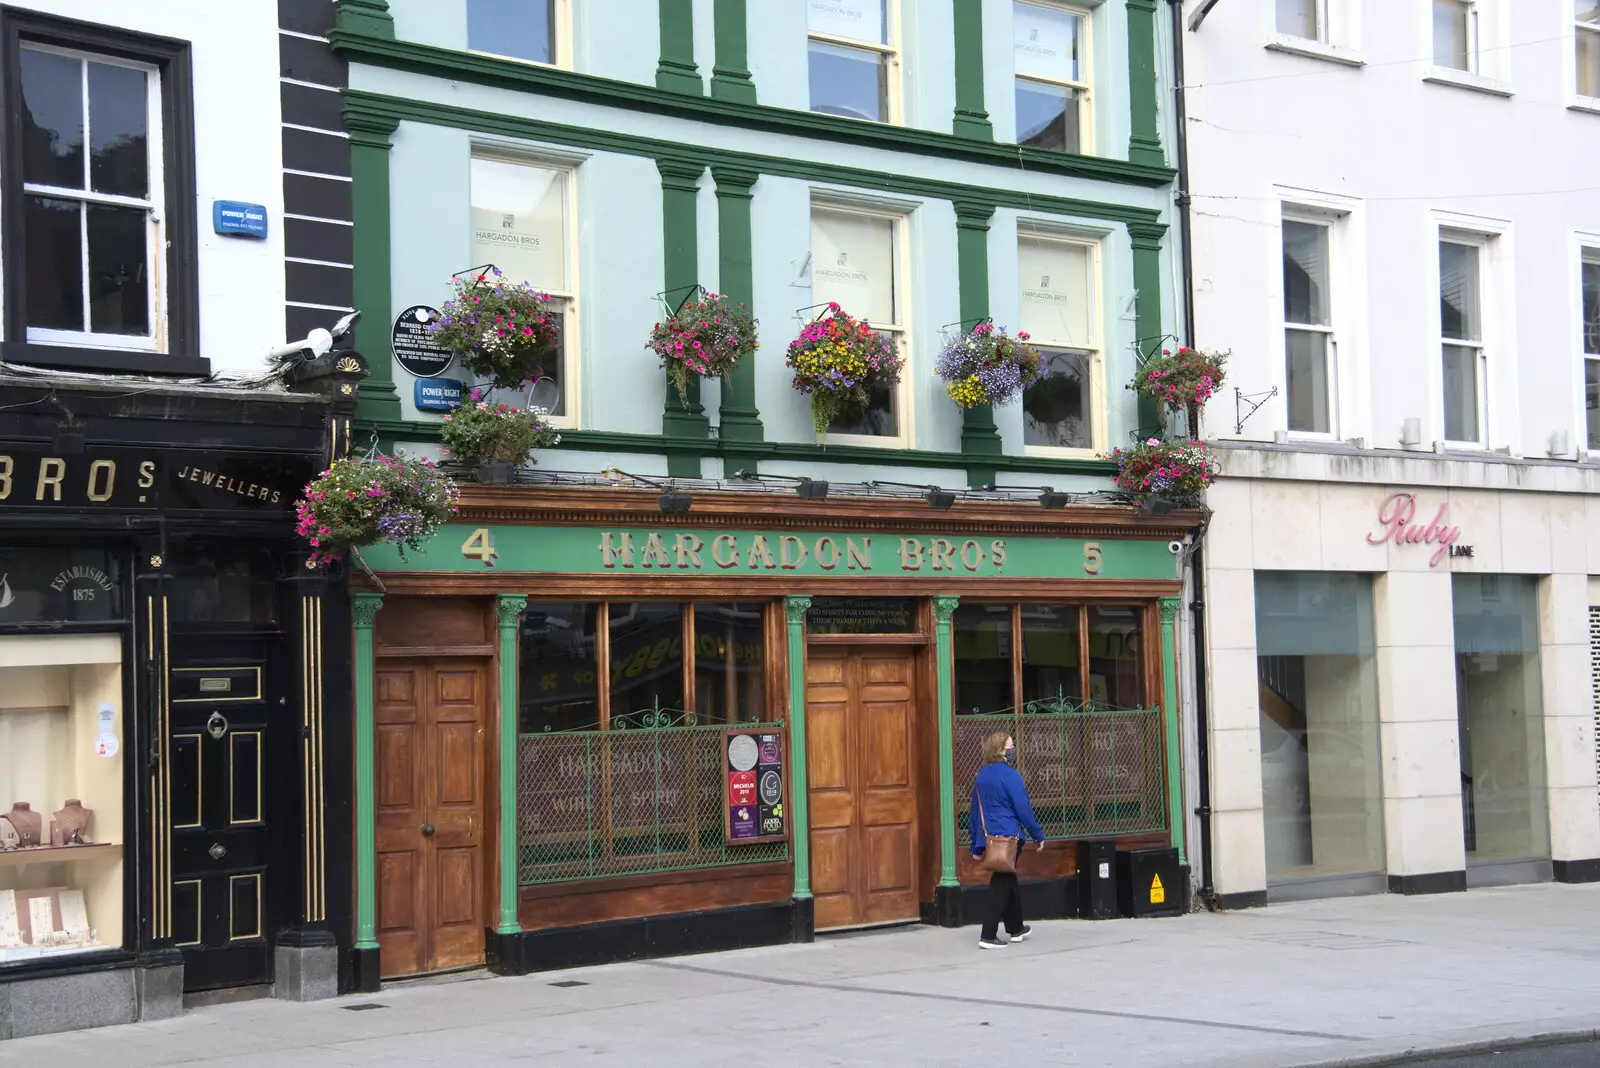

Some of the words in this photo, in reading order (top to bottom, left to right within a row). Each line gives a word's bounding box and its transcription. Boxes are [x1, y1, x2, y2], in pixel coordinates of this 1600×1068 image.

[221, 210, 244, 218] POWER
[476, 231, 519, 243] HARGADON
[521, 236, 540, 246] BROS
[815, 269, 851, 280] HARGADON
[852, 273, 867, 281] BROS
[1023, 291, 1053, 300] HARGADON
[1054, 294, 1068, 302] BROS
[422, 387, 442, 397] POWER
[444, 389, 460, 398] RIGHT
[178, 466, 281, 503] JEWELLERS
[1366, 492, 1461, 567] Ruby
[1449, 544, 1474, 558] LANE
[461, 528, 499, 567] 4
[597, 531, 873, 571] HARGADON
[1082, 542, 1104, 576] 5
[49, 565, 115, 592] ESTABLISHED
[73, 588, 95, 601] 1875
[763, 821, 782, 831] FOOD
